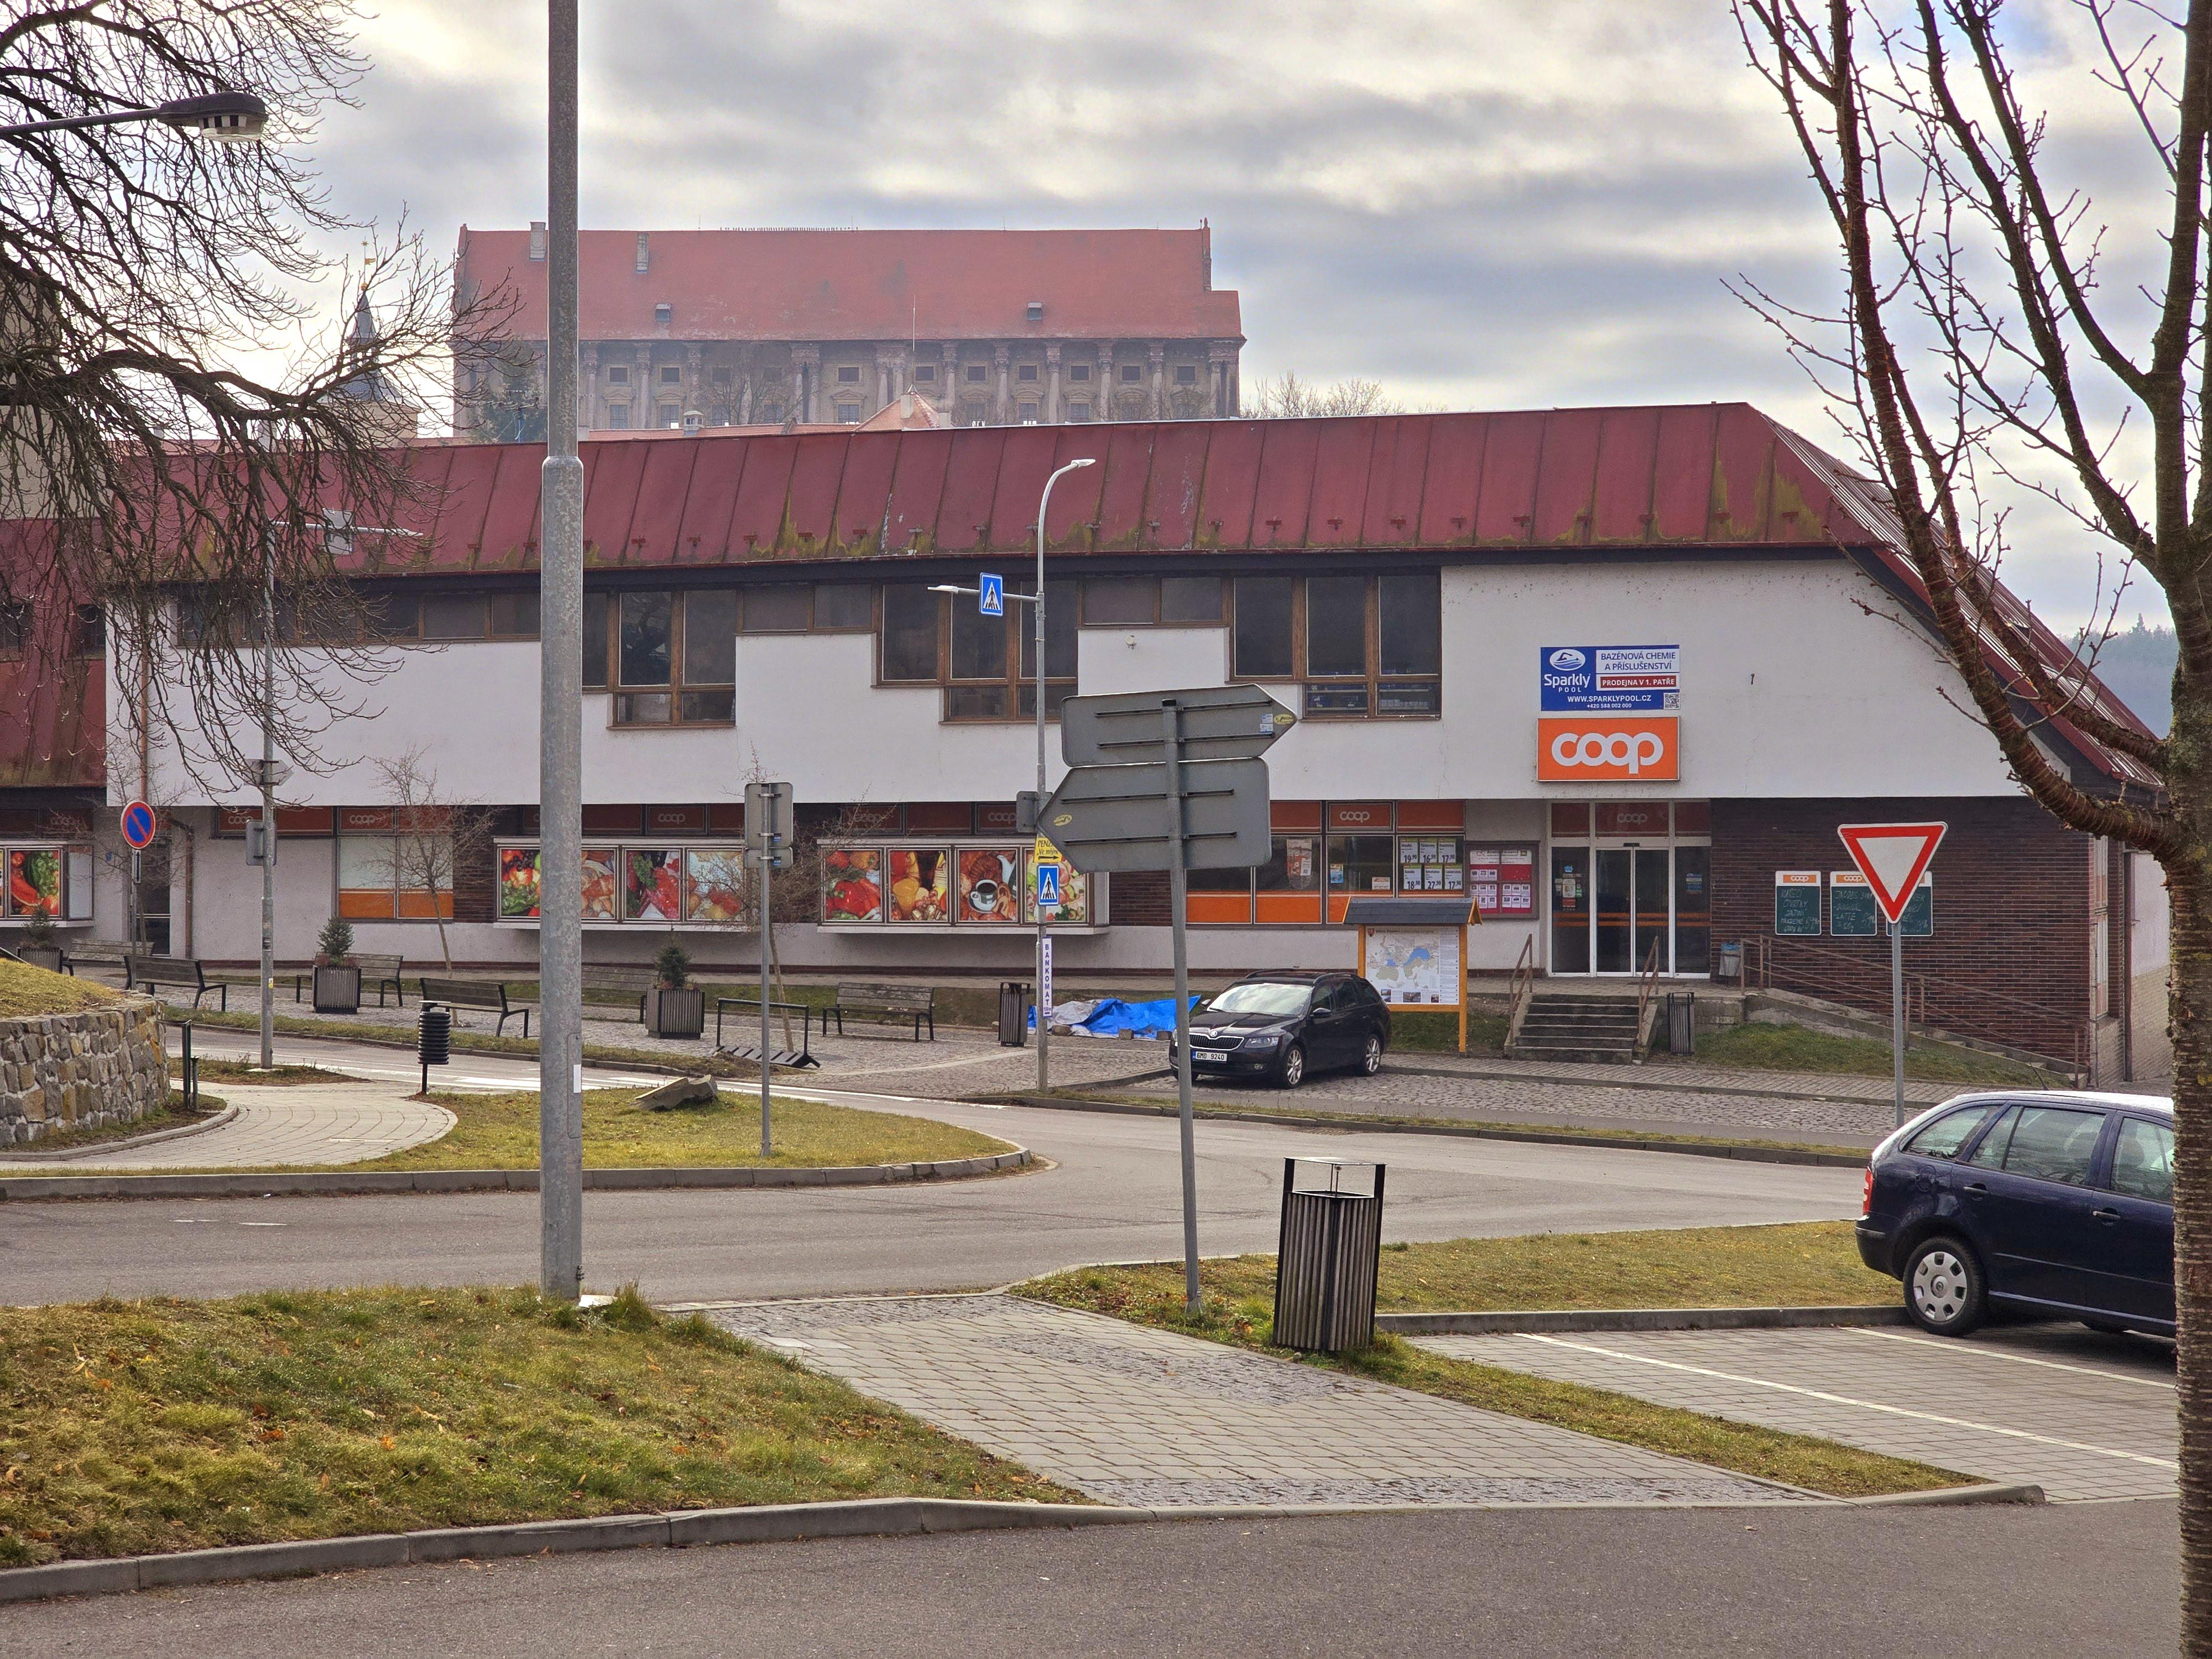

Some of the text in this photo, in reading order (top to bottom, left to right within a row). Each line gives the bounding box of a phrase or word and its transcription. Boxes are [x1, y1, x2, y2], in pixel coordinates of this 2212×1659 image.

[1601, 651, 1644, 660] BAZÉNOVÁ
[1613, 660, 1672, 670] PŘÍSLUŠENSTVÍ
[1544, 673, 1590, 688] Sparkly
[1552, 732, 1664, 774] coop
[349, 815, 375, 826] coop
[658, 813, 685, 825] coop
[988, 812, 1016, 823] coop
[1340, 811, 1370, 823] coop
[1617, 813, 1647, 825] coop
